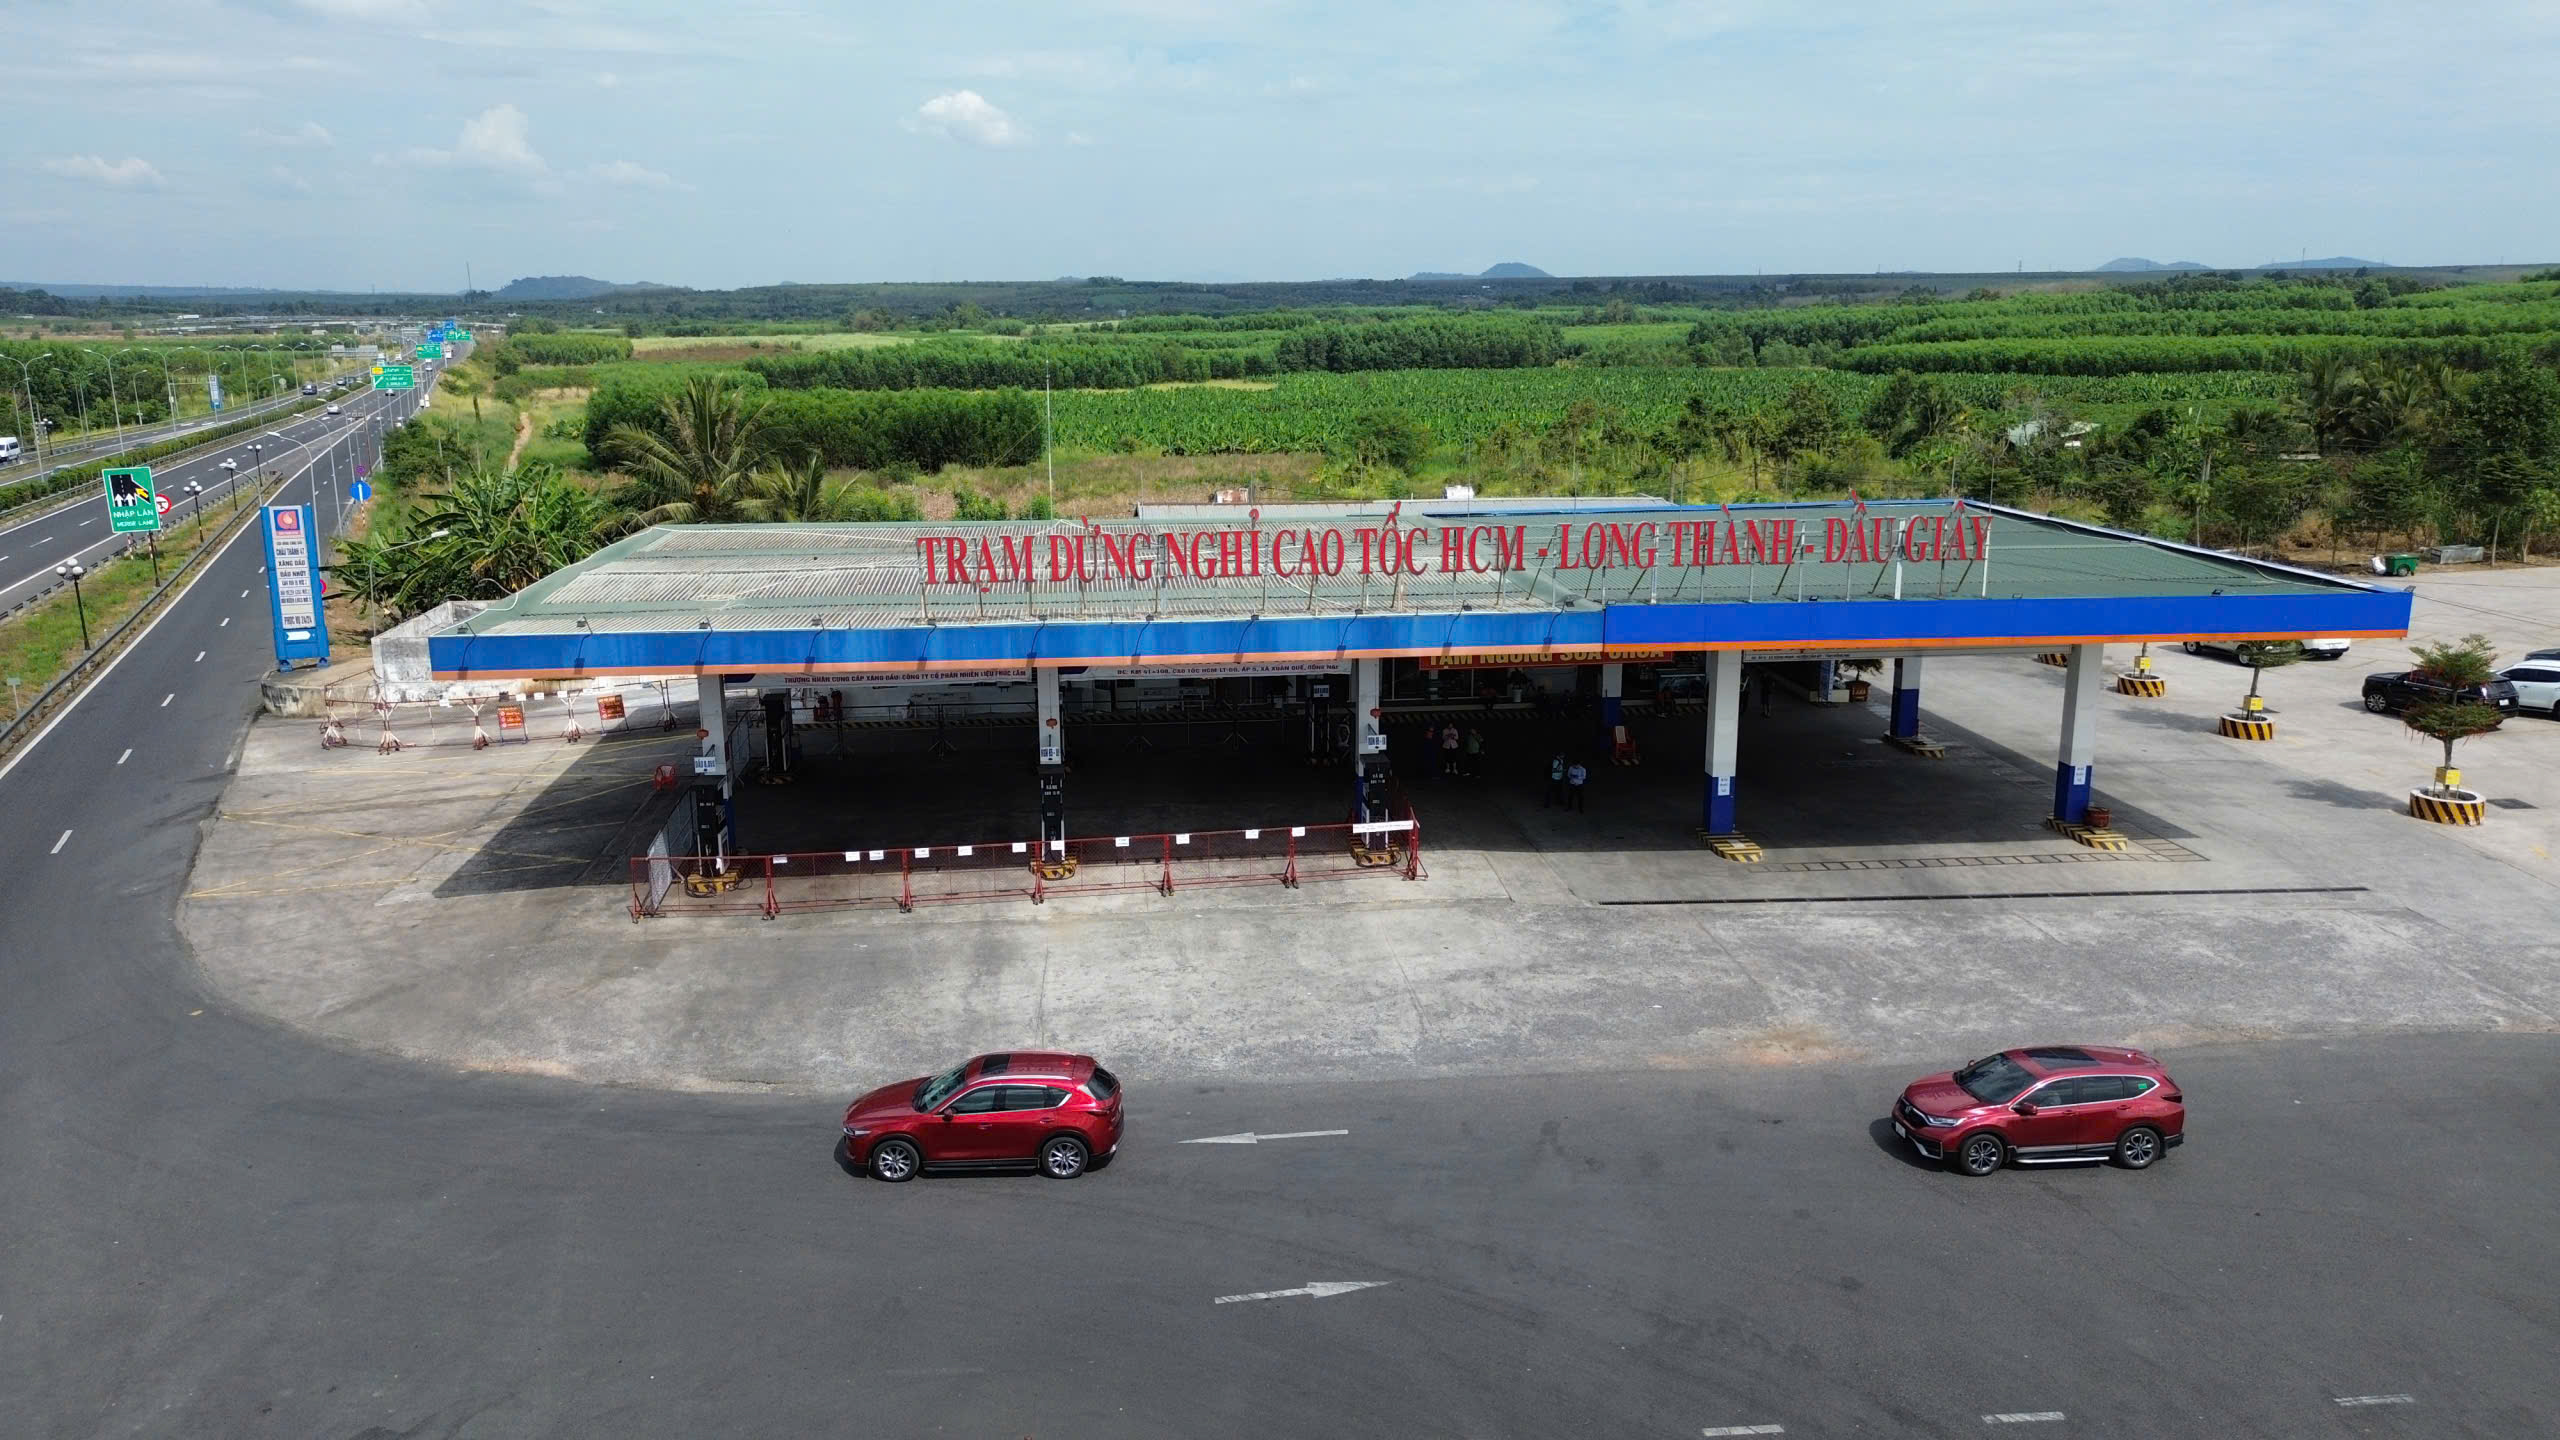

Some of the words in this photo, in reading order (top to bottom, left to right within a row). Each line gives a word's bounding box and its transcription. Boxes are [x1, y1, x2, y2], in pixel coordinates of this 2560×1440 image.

[916, 535, 1036, 593] TRẠM
[1050, 515, 1155, 583] DỪNG
[1165, 509, 1262, 580] NGHỈ
[1272, 528, 1345, 578] CAO
[1354, 501, 1428, 576] TỐC
[1438, 525, 1527, 573] HCM
[1555, 521, 1658, 570] LONG
[1668, 504, 1797, 567] THÀNH
[1824, 490, 1896, 564] DẦU
[1904, 500, 1993, 563] GIÂY
[960, 670, 979, 678] NHIÊN
